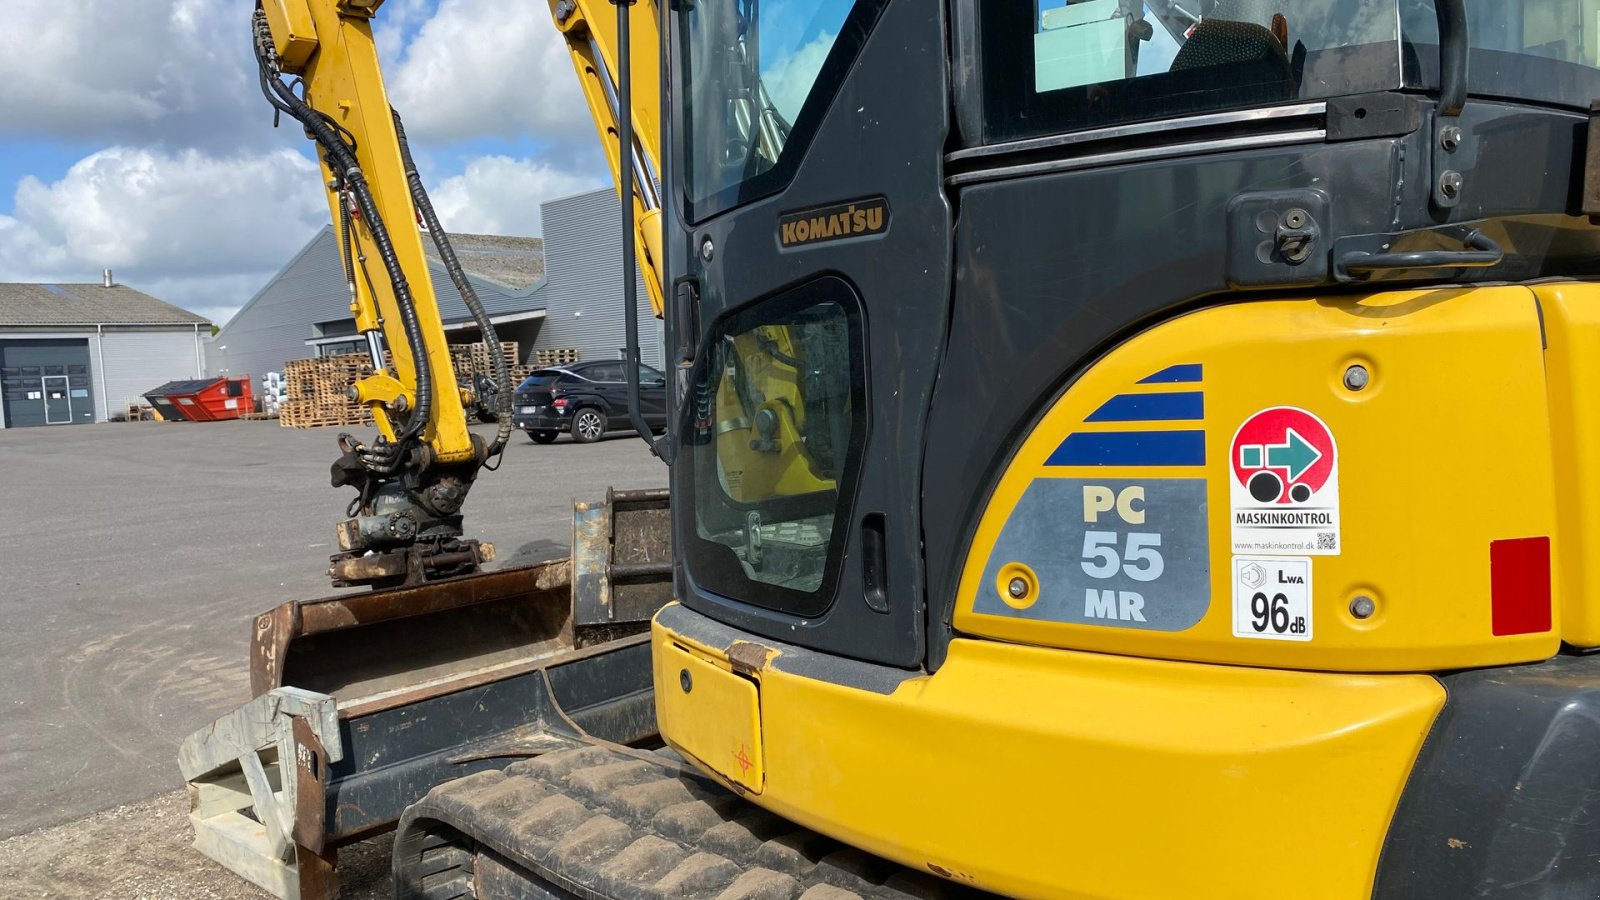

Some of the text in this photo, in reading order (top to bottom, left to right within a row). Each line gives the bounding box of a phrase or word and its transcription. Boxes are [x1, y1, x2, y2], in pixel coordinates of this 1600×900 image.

[783, 205, 883, 244] KOMATSU
[1083, 485, 1145, 525] PC
[1236, 512, 1333, 525] MASKINKONTROL
[1080, 530, 1164, 582] 55
[1234, 541, 1315, 551] www.maskinkontrol.dk
[1084, 588, 1147, 622] MR
